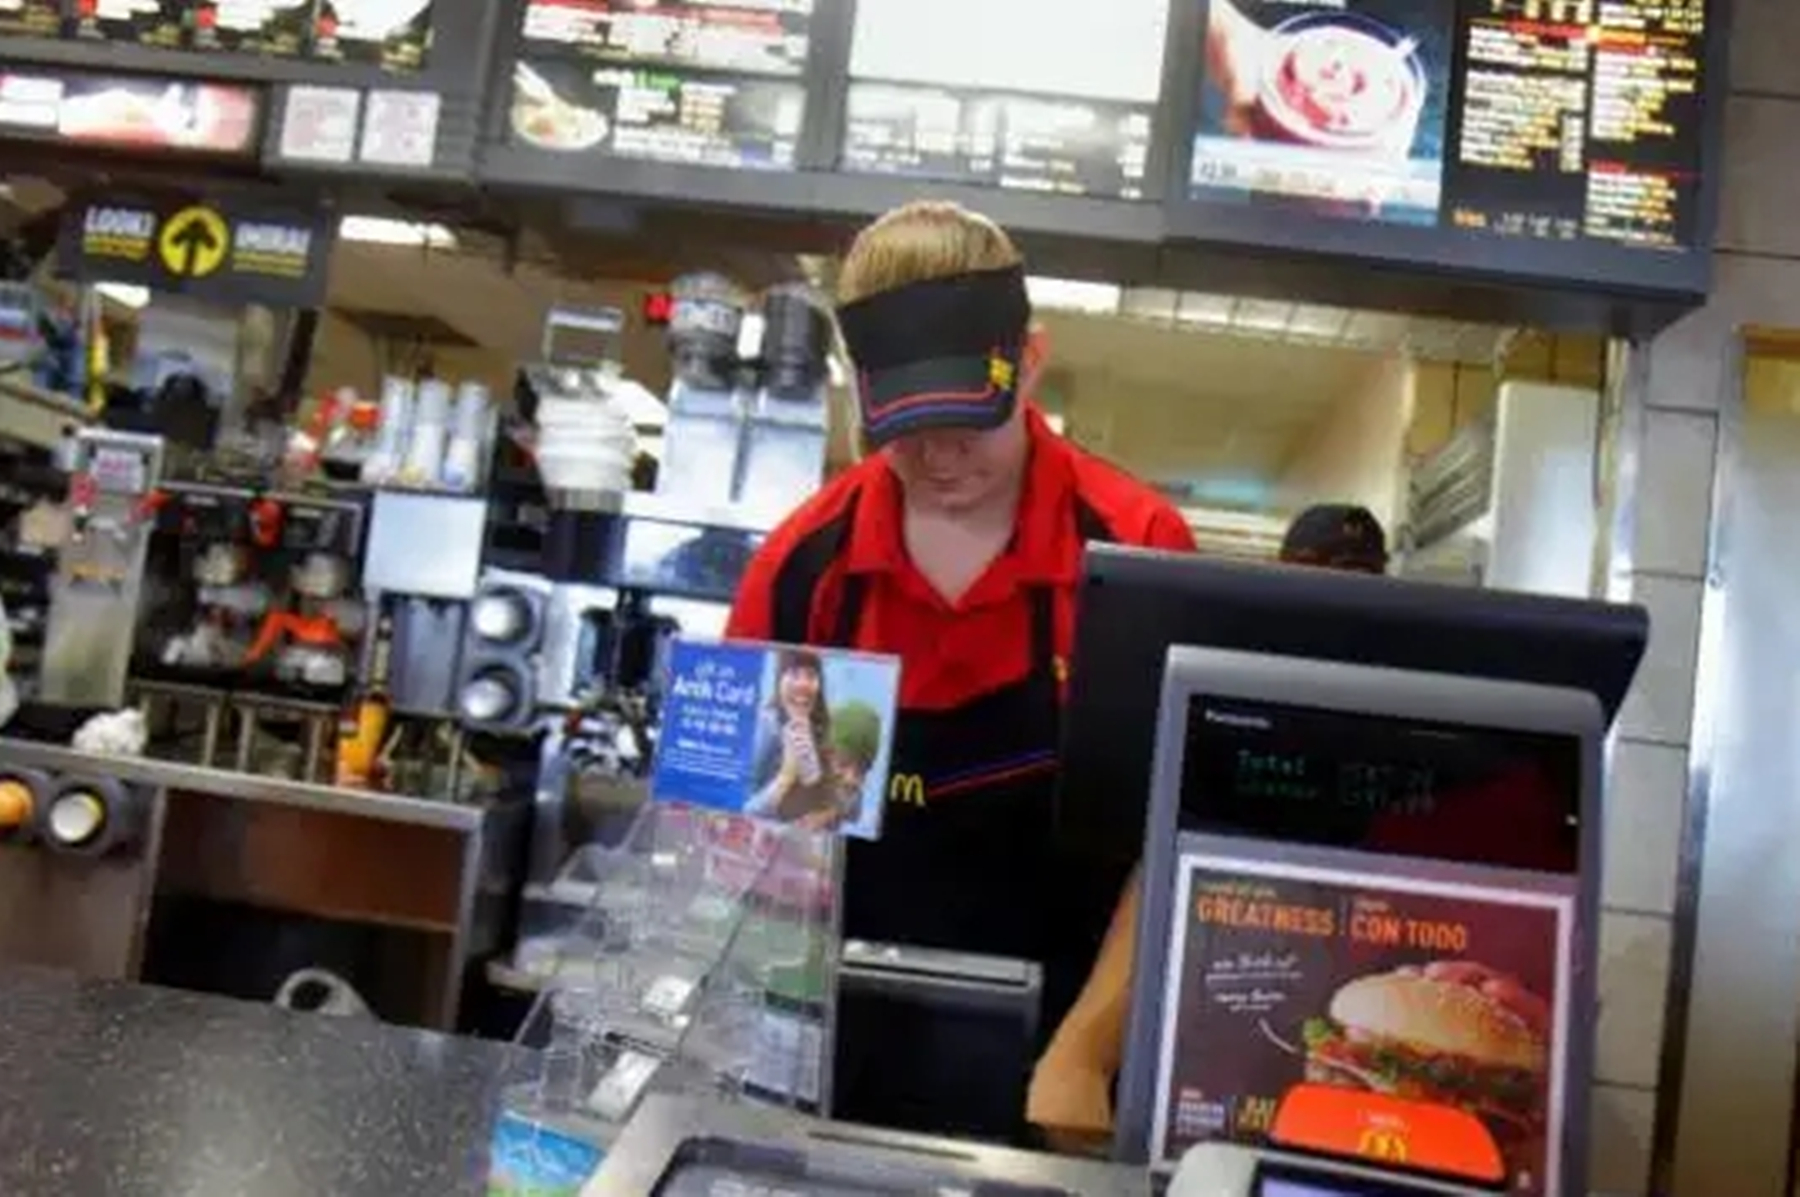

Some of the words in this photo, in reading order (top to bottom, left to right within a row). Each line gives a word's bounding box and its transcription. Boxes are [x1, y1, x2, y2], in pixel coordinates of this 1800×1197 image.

[673, 674, 712, 700] Arch
[715, 680, 755, 705] Card
[1197, 893, 1335, 935] GREATNESS
[1350, 912, 1400, 943] CON
[1405, 918, 1467, 950] TODO
